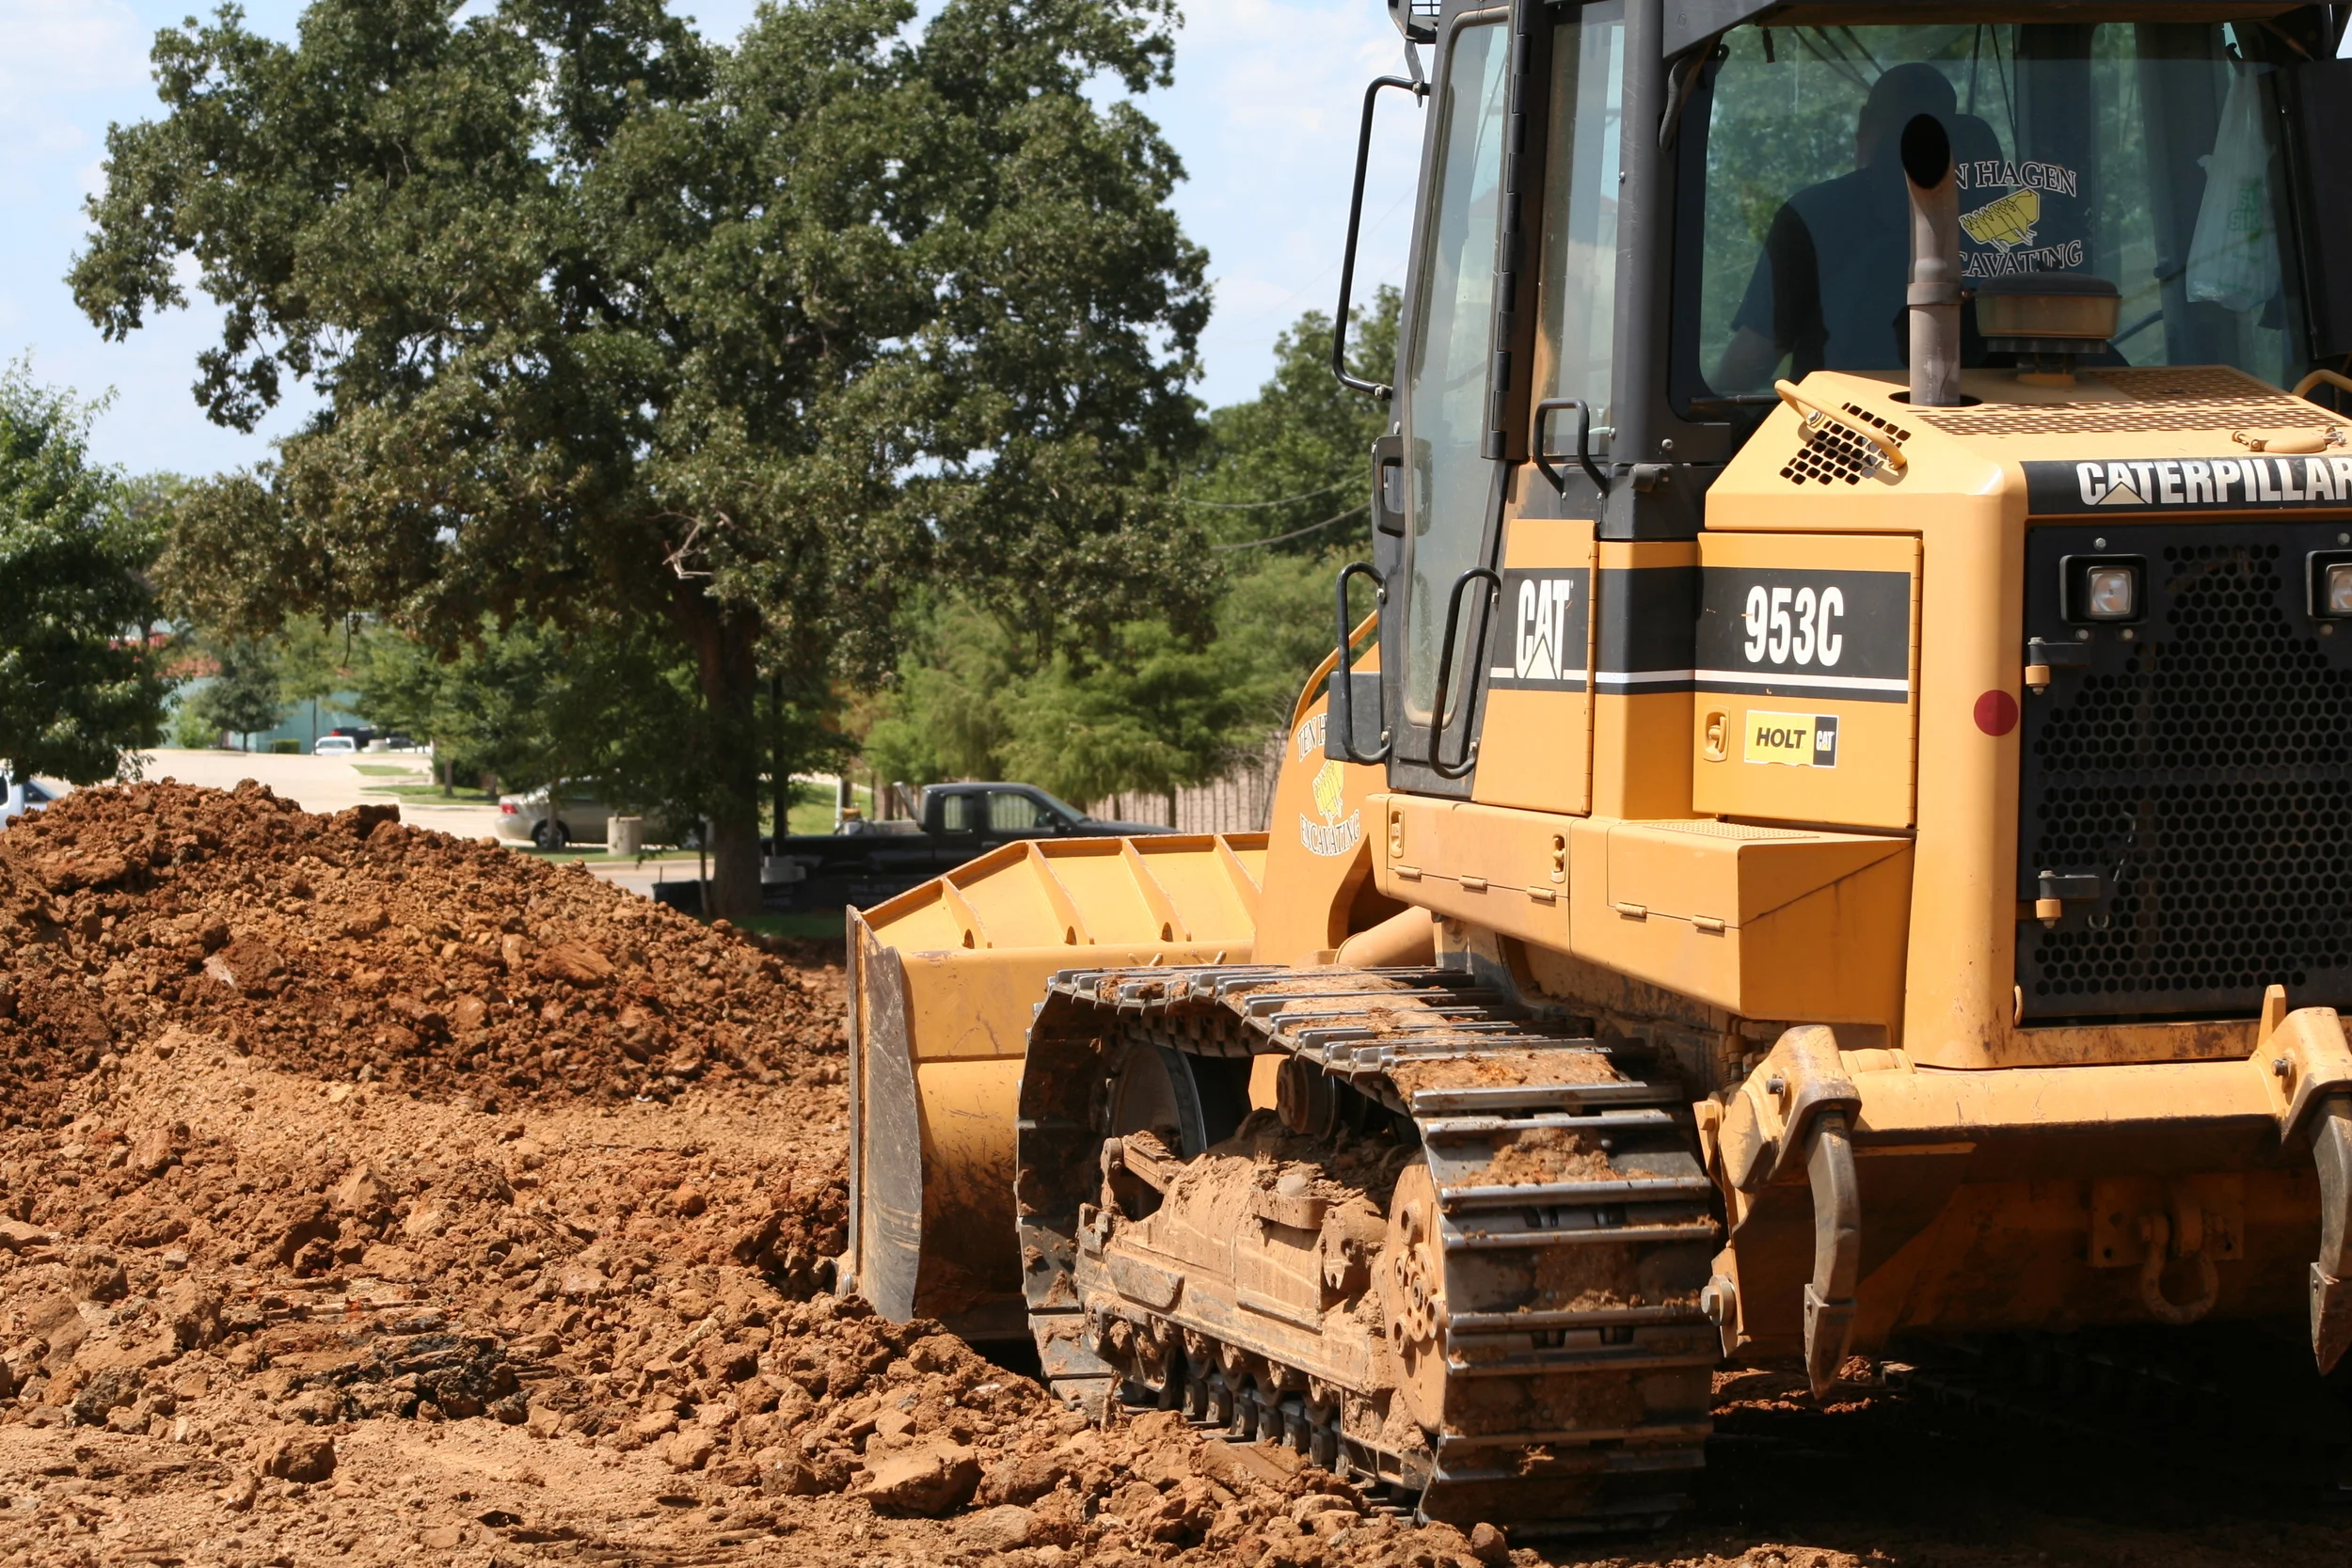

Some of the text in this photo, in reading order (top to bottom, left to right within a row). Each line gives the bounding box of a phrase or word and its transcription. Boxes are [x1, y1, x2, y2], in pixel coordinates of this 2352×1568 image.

[1974, 161, 2076, 198] HAGEN
[2075, 457, 2352, 505] CATERPILLAR
[1515, 579, 1570, 679] CAT
[1743, 585, 1844, 667] 953C
[1756, 727, 1835, 751] HOLT CAT
[1300, 809, 1360, 857] EXCAVATING
